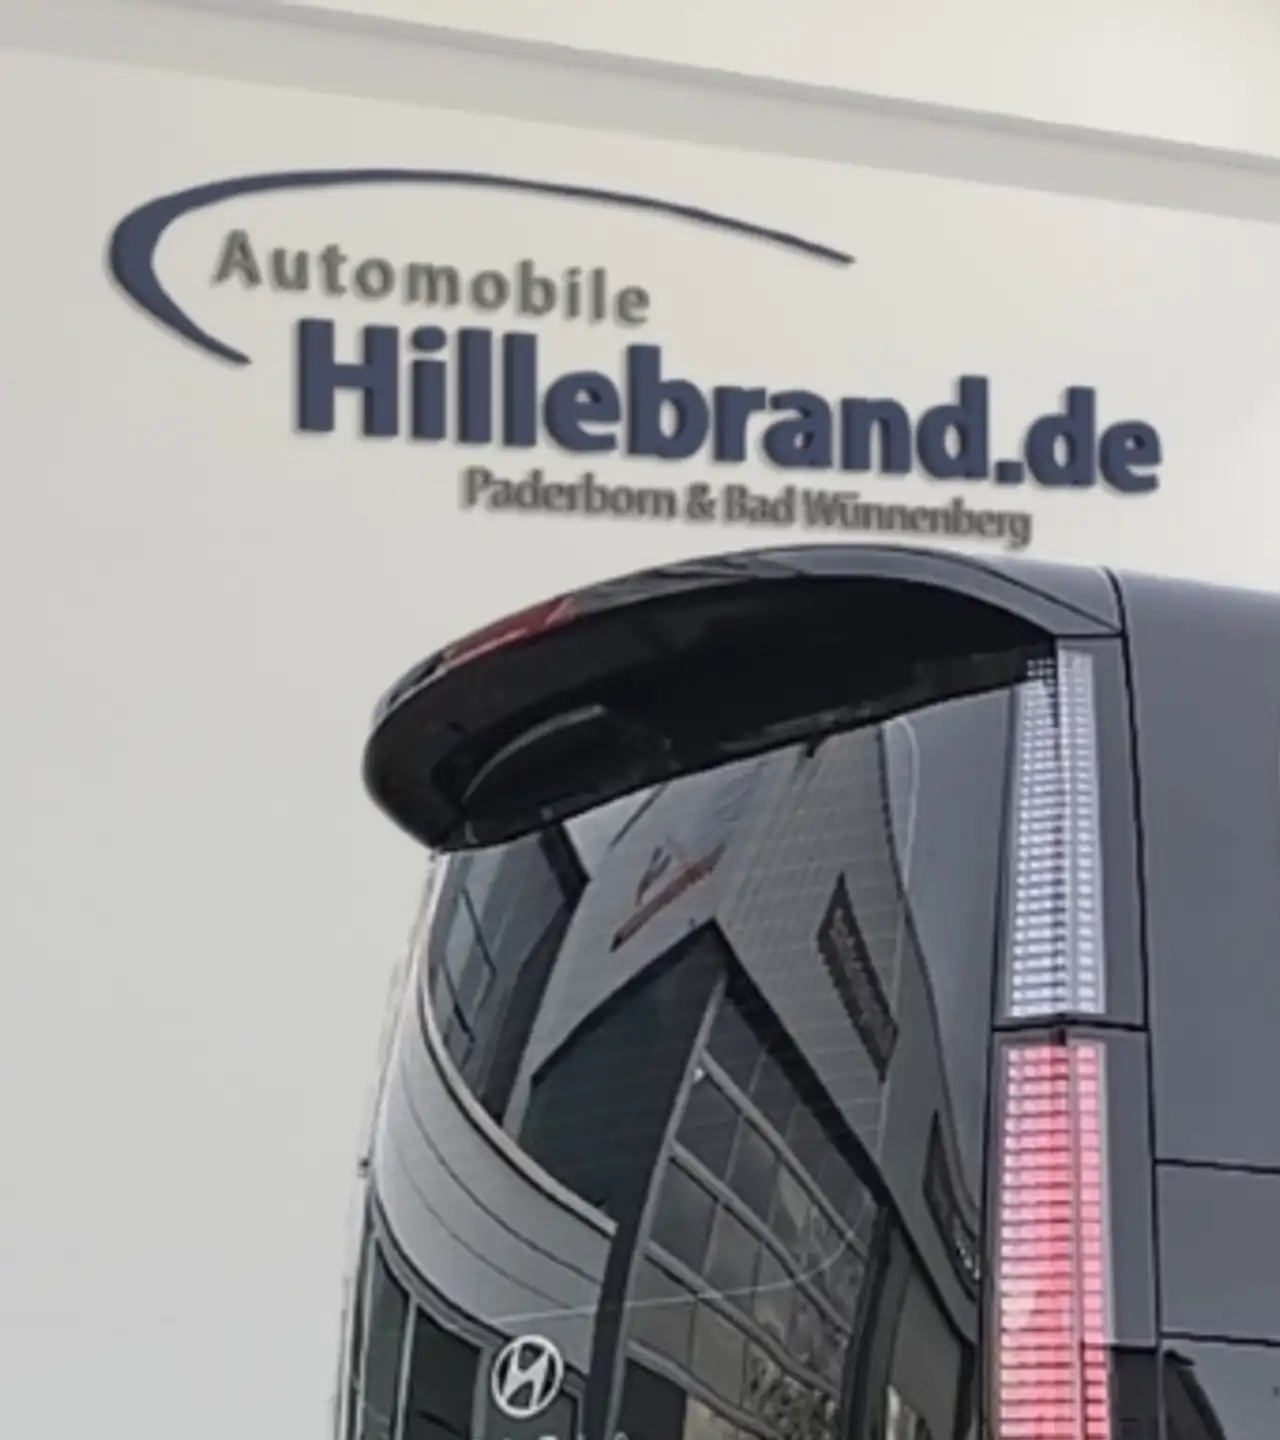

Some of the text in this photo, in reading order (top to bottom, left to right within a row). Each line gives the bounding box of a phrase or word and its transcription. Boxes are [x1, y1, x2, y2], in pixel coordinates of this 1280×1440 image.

[213, 228, 651, 326] Automobile
[294, 317, 1163, 495] Hillebrand.de
[462, 465, 1032, 547] Paderborn & Bad Wünnenberg
